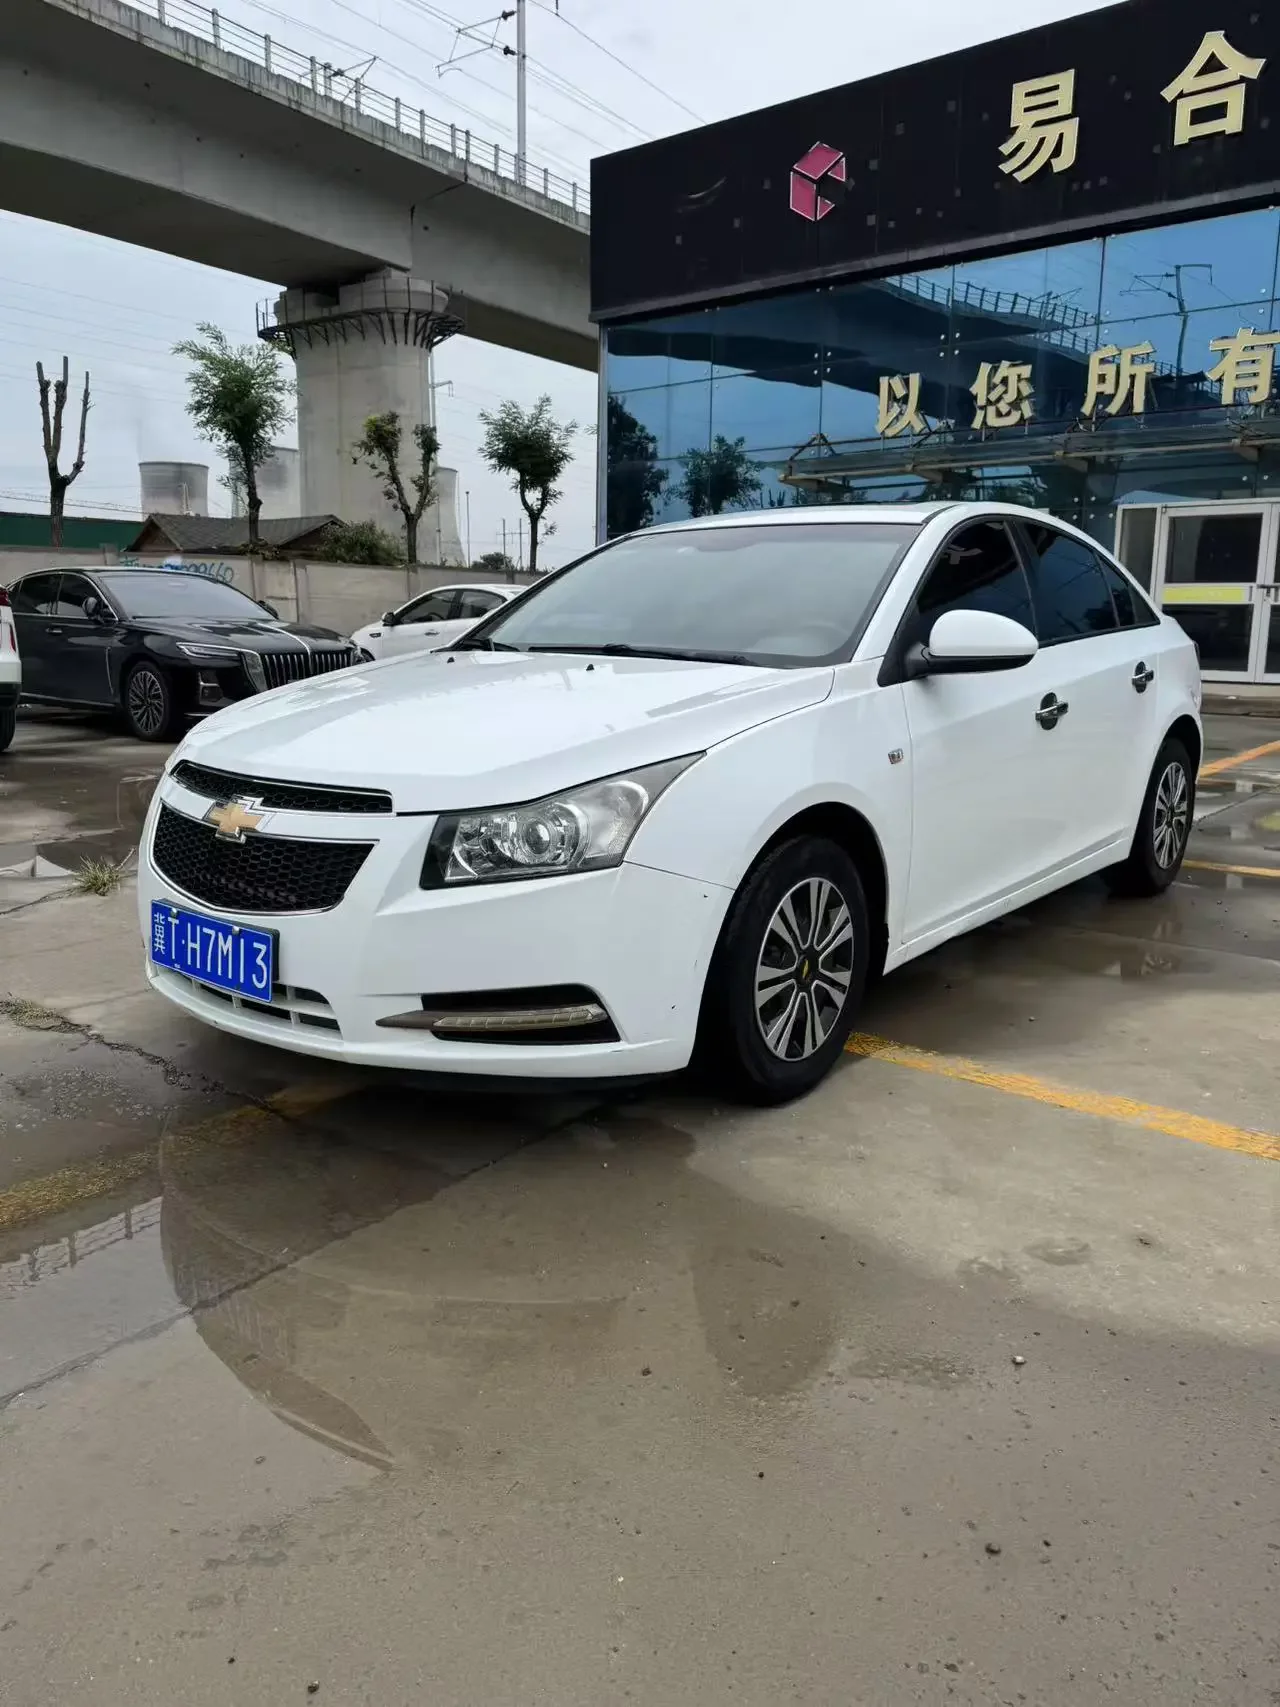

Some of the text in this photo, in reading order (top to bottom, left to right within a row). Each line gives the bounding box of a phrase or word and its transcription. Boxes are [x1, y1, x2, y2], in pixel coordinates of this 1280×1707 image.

[998, 30, 1267, 183] 易合
[876, 327, 1280, 437] 以您所有
